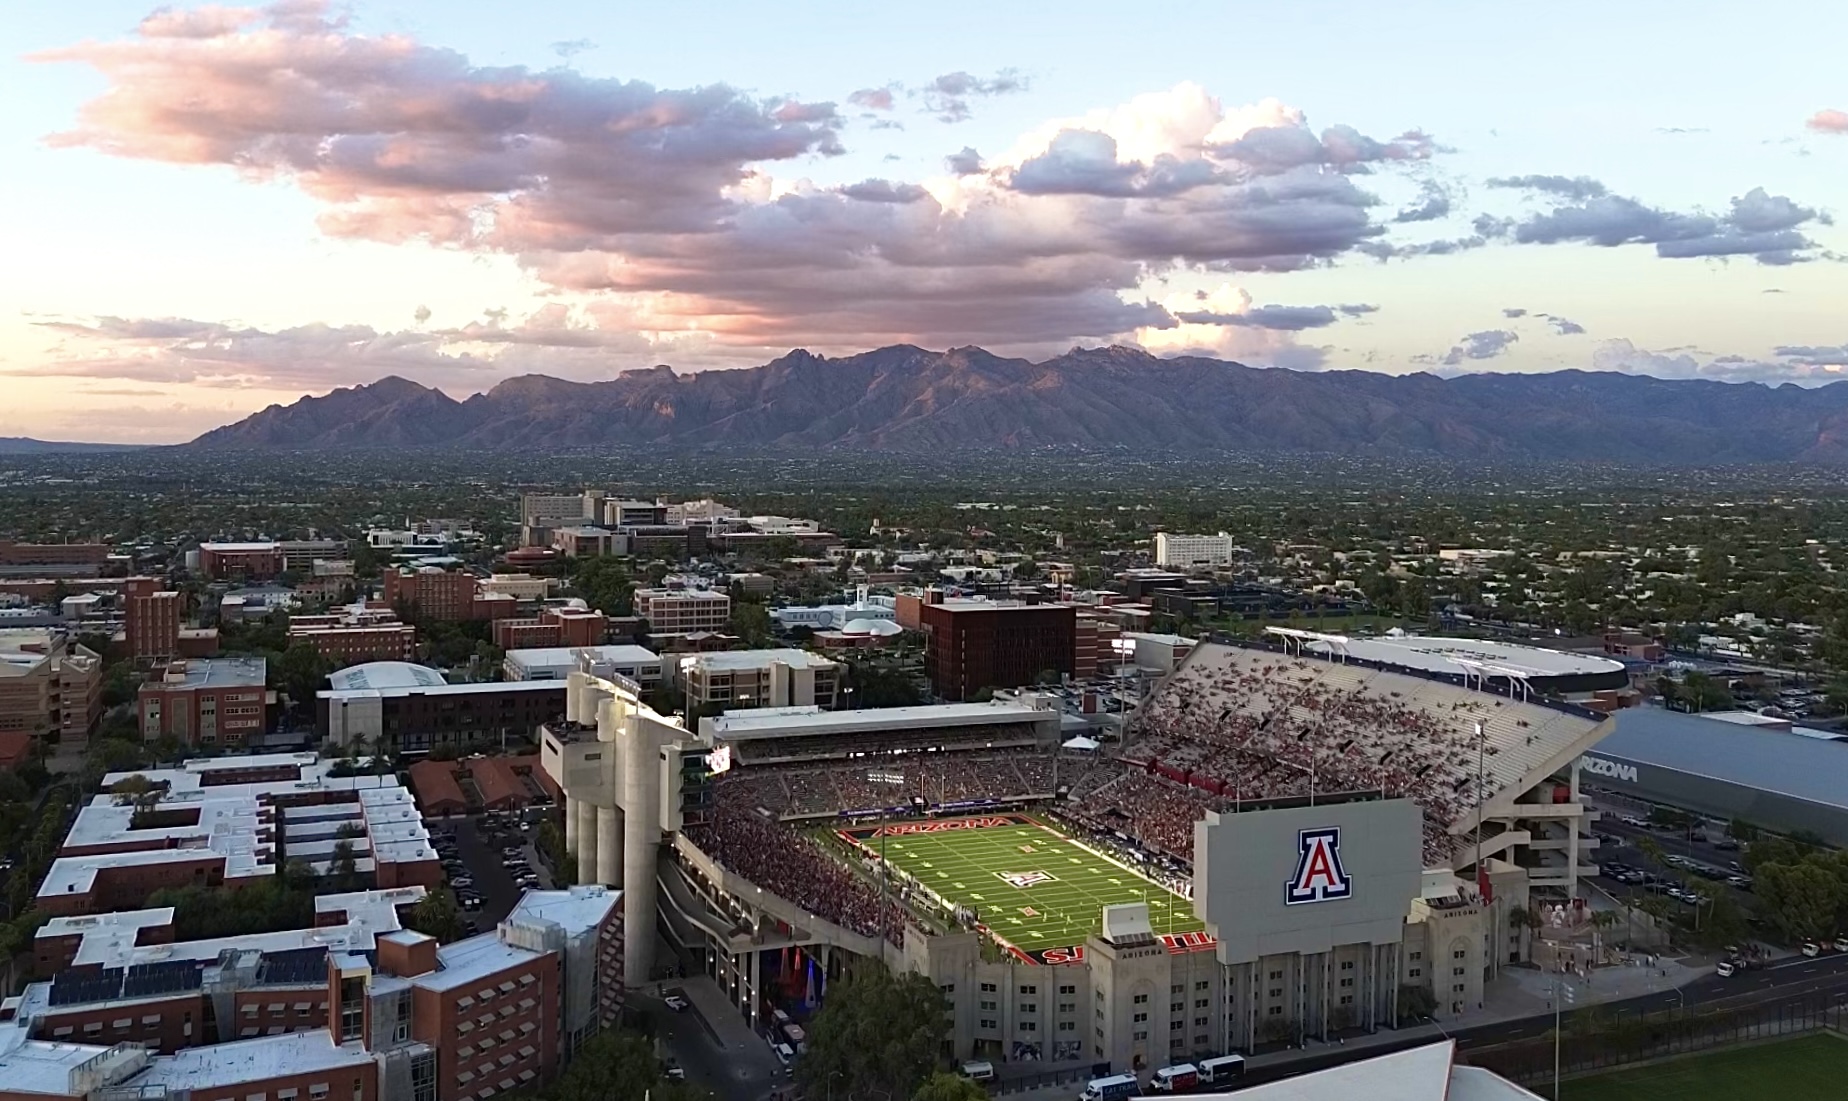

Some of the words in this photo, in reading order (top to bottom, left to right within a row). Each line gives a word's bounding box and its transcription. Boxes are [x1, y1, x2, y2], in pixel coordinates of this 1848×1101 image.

[1579, 755, 1638, 783] RIZONA
[1285, 826, 1352, 905] A
[1444, 909, 1478, 919] ARIZONA
[1122, 949, 1163, 960] ARIZONA
